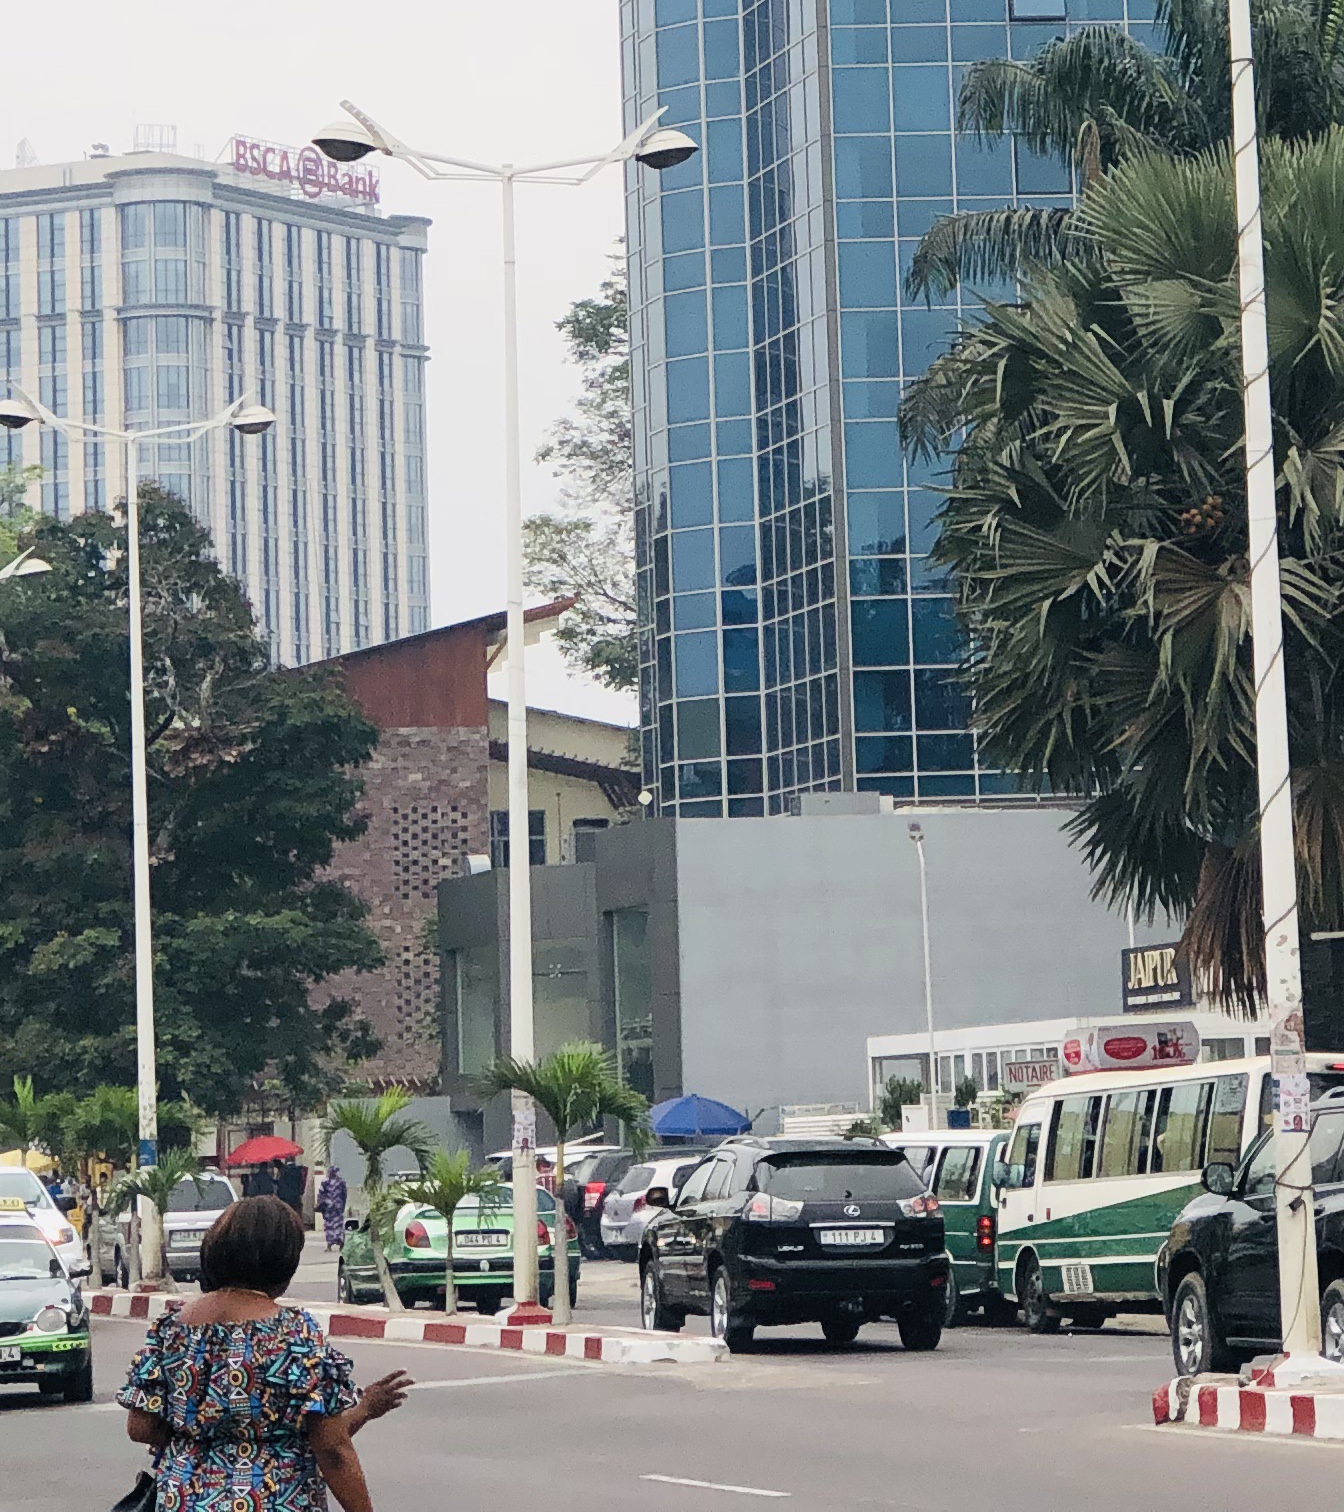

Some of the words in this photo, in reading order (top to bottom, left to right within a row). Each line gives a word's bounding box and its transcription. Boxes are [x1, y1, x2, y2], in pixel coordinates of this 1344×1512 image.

[234, 139, 293, 183] BSCA
[328, 161, 380, 202] Bank
[1127, 947, 1179, 990] JAIPUR
[1008, 1063, 1055, 1083] NOTAIRE
[832, 1231, 849, 1243] 111
[854, 1231, 867, 1243] PJ
[870, 1230, 877, 1241] 4
[7, 1347, 15, 1359] 4
